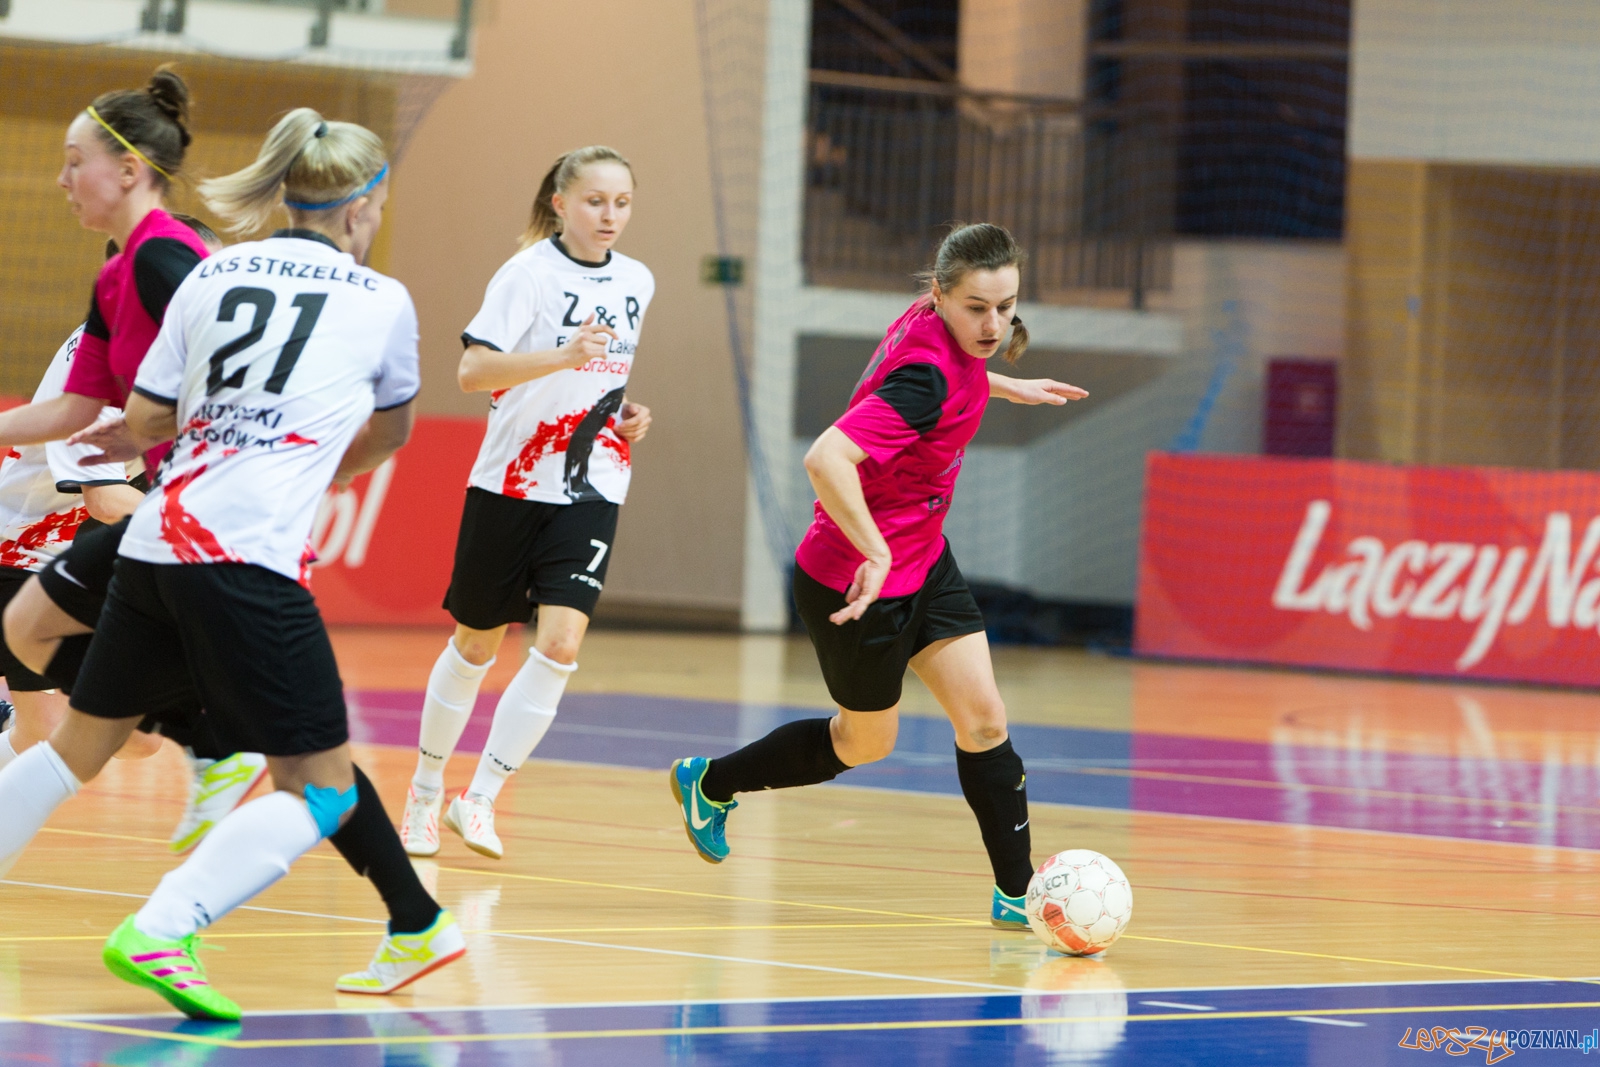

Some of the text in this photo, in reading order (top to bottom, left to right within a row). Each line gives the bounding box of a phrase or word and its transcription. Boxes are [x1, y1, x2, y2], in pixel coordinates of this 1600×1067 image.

[199, 255, 379, 291] LKS STRZELEC
[562, 291, 583, 327] Z
[596, 306, 617, 329] &
[205, 286, 329, 396] 21
[586, 538, 608, 573] 7
